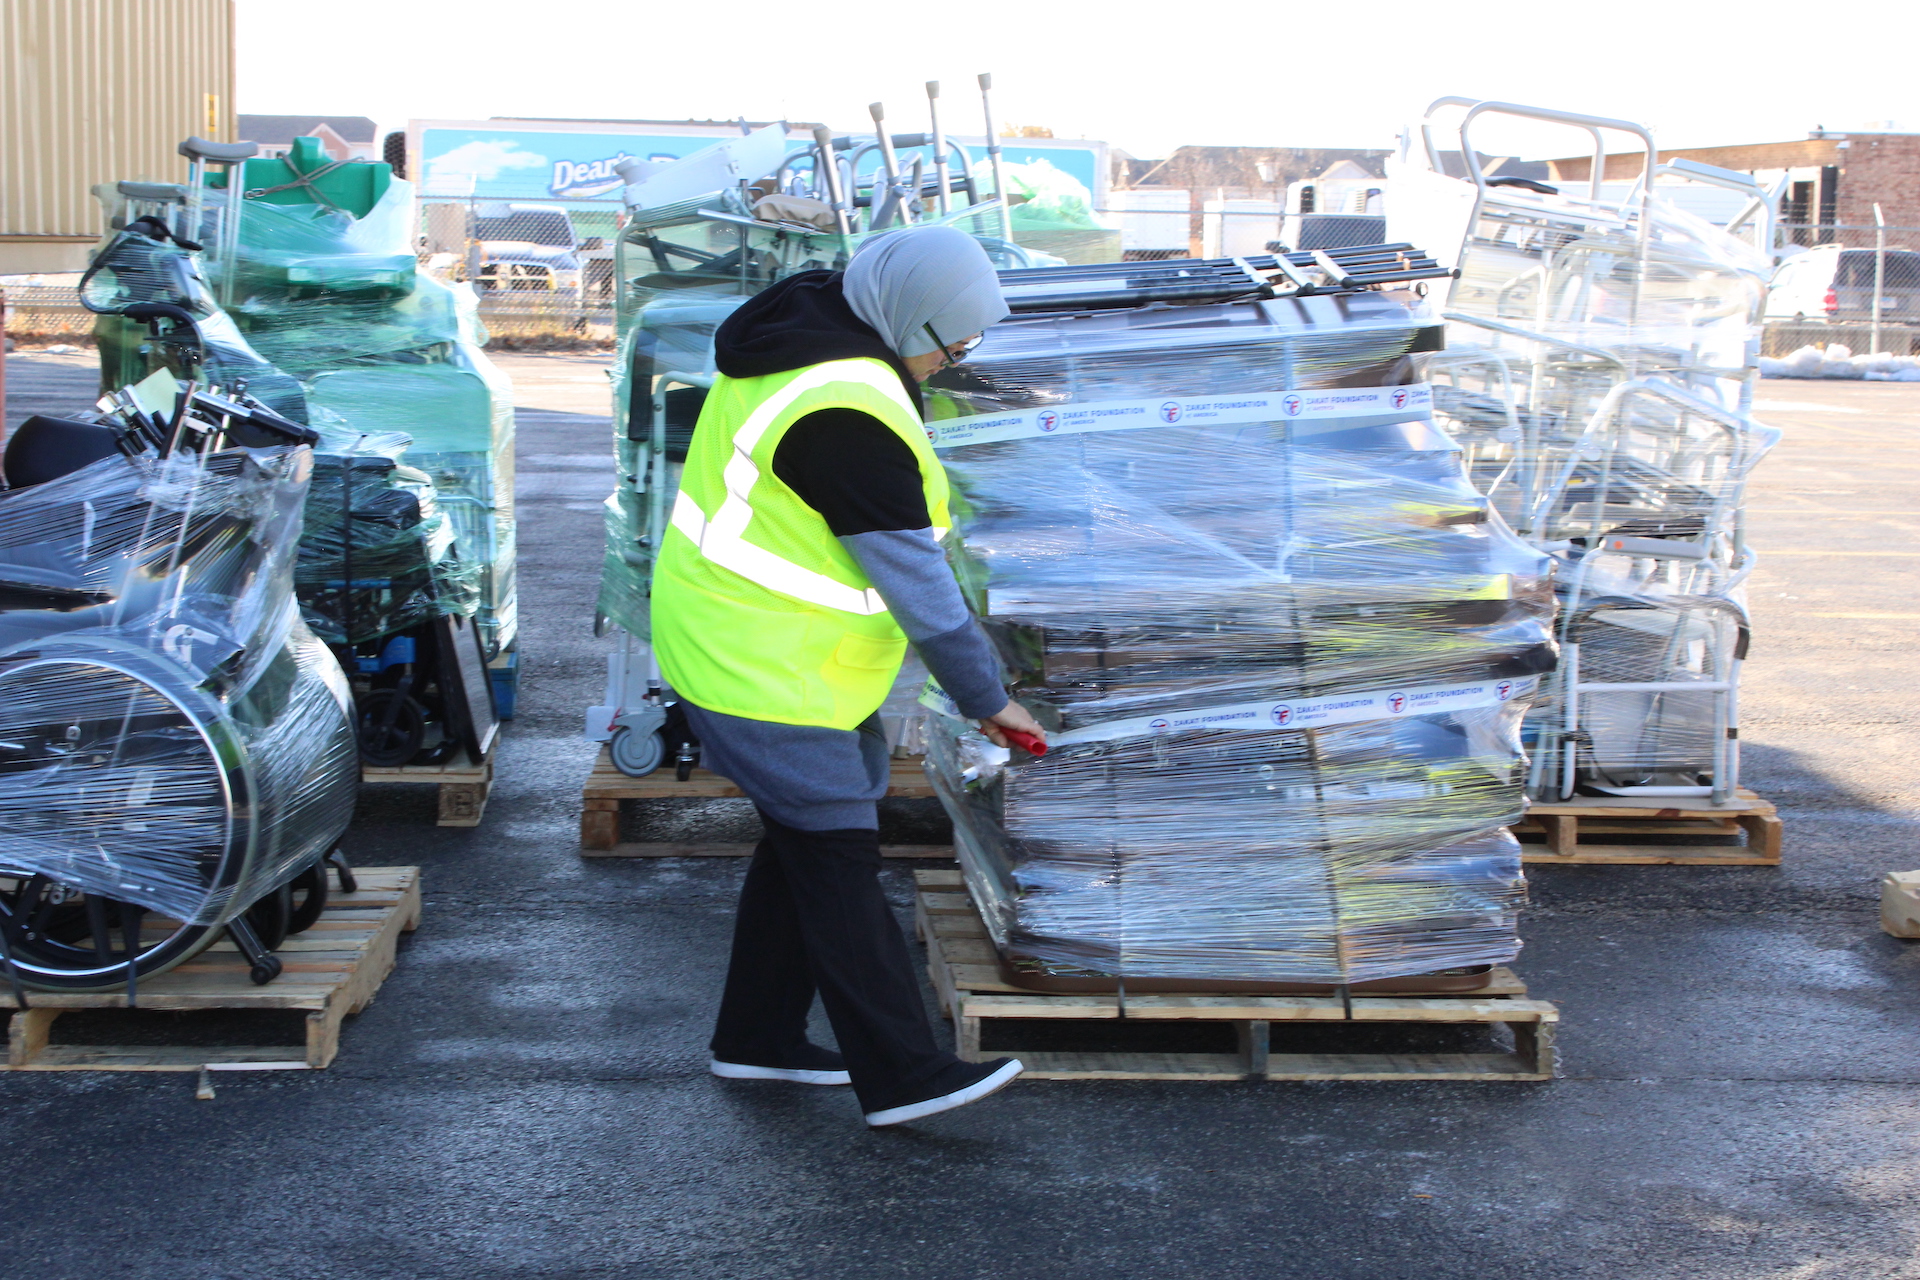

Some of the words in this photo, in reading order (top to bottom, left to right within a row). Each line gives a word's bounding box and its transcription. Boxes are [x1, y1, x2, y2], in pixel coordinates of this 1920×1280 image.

[1185, 404, 1211, 412] ZAKAT
[1213, 401, 1268, 410] FOUNDATION
[1305, 397, 1329, 405] ZAKAT
[1330, 394, 1379, 404] FOUNDATION
[1062, 411, 1088, 420] ZAKAT
[1091, 407, 1146, 416] FOUNDATION
[941, 424, 966, 434] ZAKAT
[968, 417, 1023, 430] FOUNDATION
[1410, 692, 1433, 701] ZAKAT
[1435, 687, 1484, 698] FOUNDATION
[1296, 705, 1321, 714] ZAKAT
[1323, 699, 1374, 711] FOUNDATION
[1173, 718, 1200, 727] ZAKAT
[1201, 711, 1257, 722] FOUNDATION
